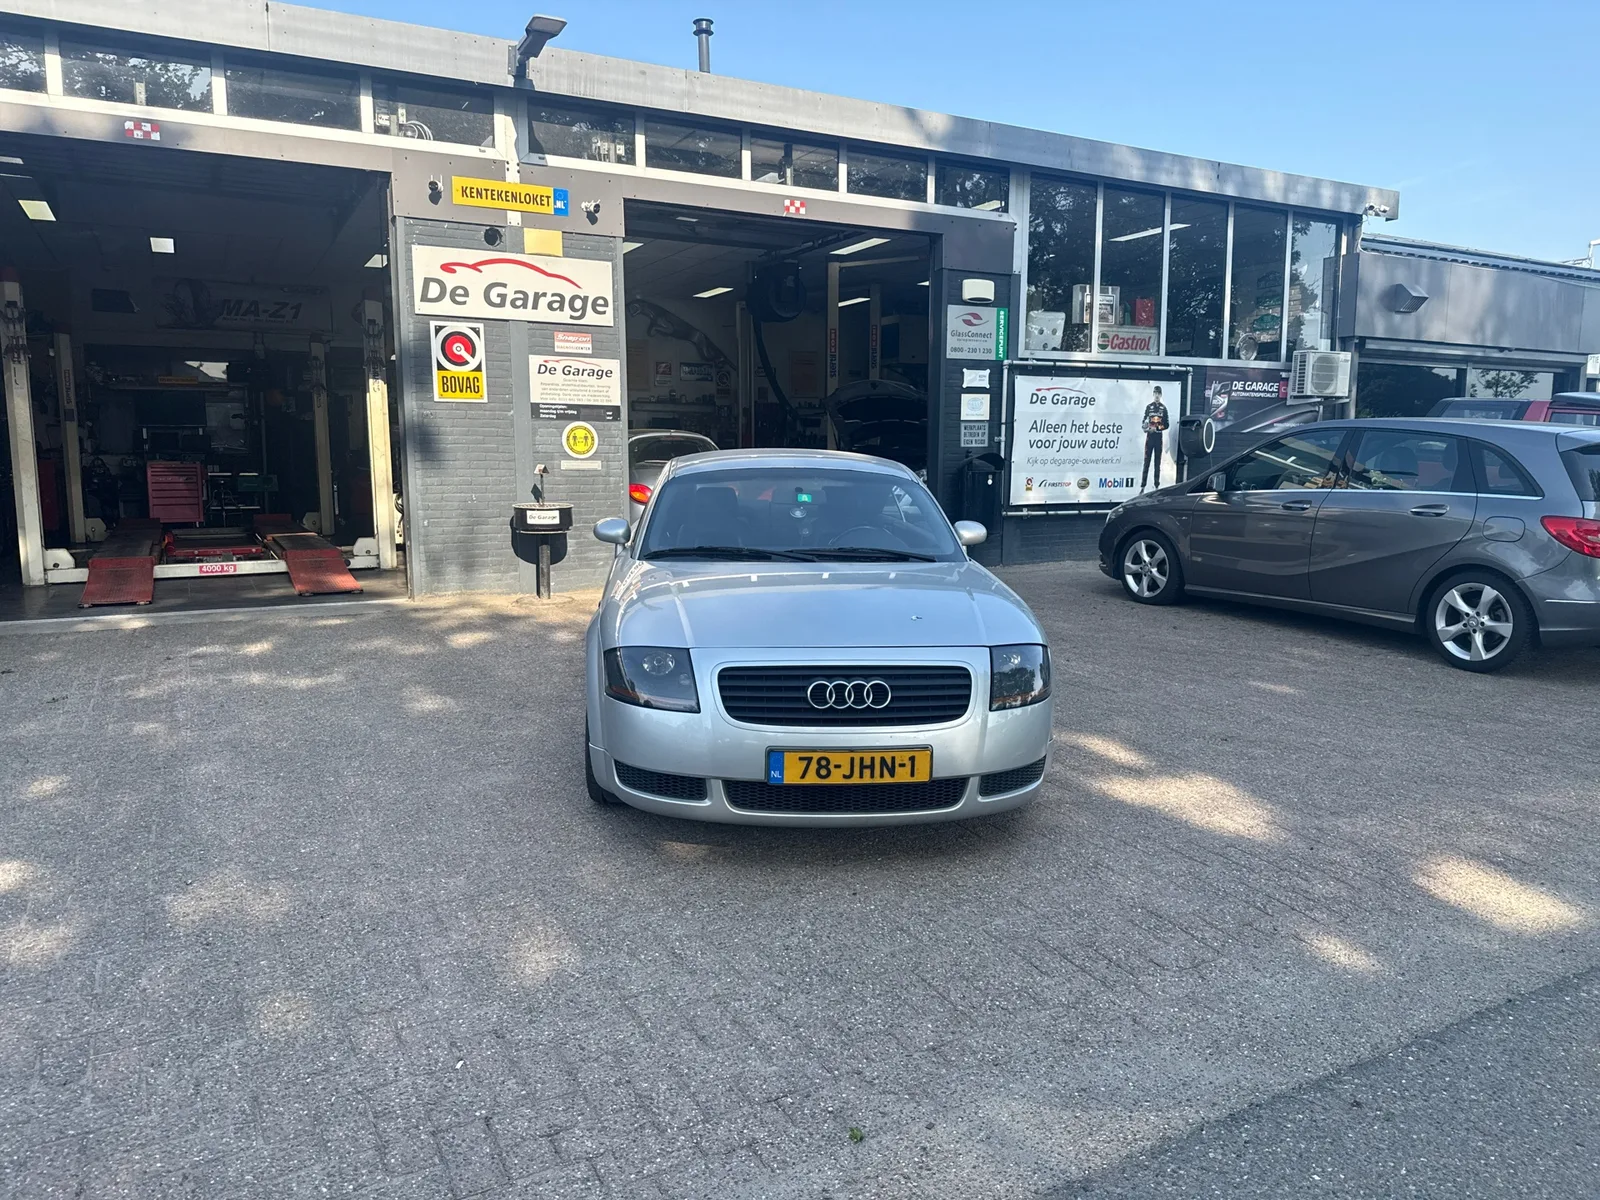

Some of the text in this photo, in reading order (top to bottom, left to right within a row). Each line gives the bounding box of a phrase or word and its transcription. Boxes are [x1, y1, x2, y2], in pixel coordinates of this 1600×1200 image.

[461, 185, 552, 207] KENTEKENLOKET
[419, 277, 609, 320] De Garage
[222, 299, 303, 320] MA-Z1
[950, 329, 992, 339] GlassConnect
[1110, 334, 1151, 351] Castrol
[537, 363, 613, 380] De Garage
[441, 375, 480, 394] BOVAG
[1232, 381, 1244, 390] DE
[1245, 381, 1279, 392] GARAGE
[1029, 392, 1096, 408] De Garage
[1028, 419, 1123, 434] Alleen het beste
[1028, 436, 1120, 453] voor jouw auto!
[1027, 457, 1122, 467] Kijk op degarage-ouwerkerk.nl
[1099, 477, 1124, 488] Mobil
[223, 564, 234, 572] kg
[770, 755, 916, 779] NL 78-JHN-1
